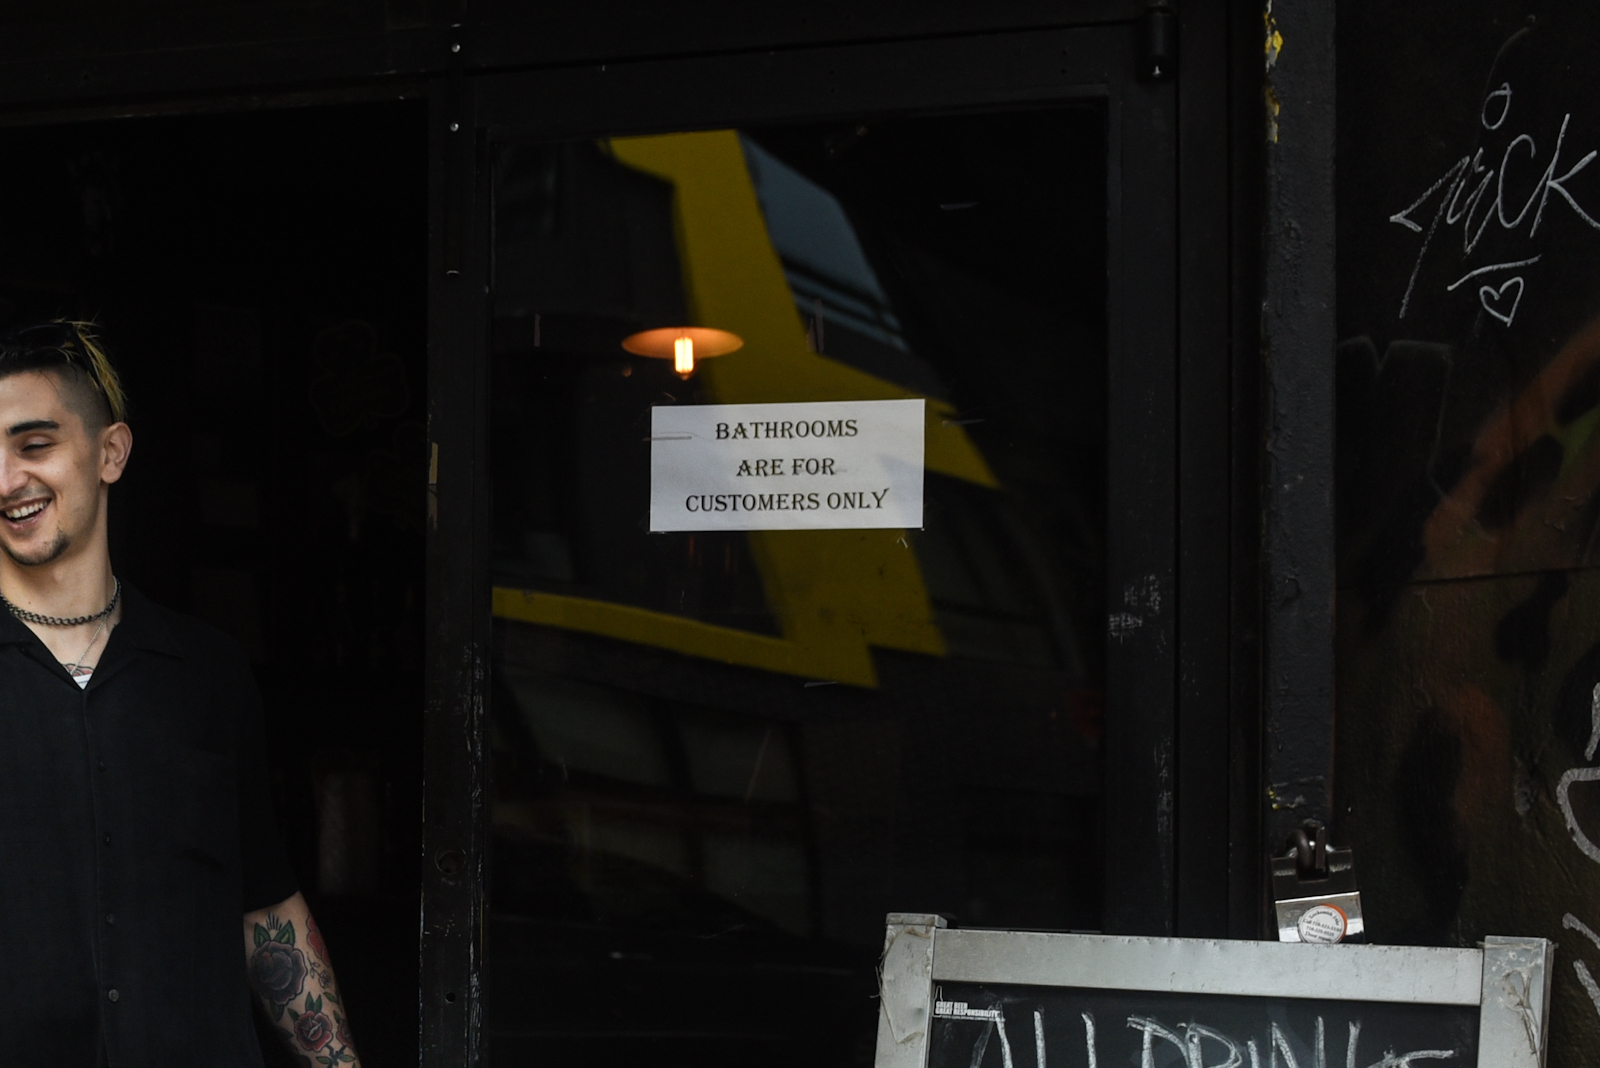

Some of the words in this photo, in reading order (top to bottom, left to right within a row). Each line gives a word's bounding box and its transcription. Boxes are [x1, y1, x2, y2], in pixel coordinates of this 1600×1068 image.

[715, 419, 859, 441] BATHROOMS
[736, 458, 784, 477] ARE
[791, 457, 836, 476] FOR
[685, 492, 820, 513] CUSTOMERS
[827, 487, 890, 510] ONLY
